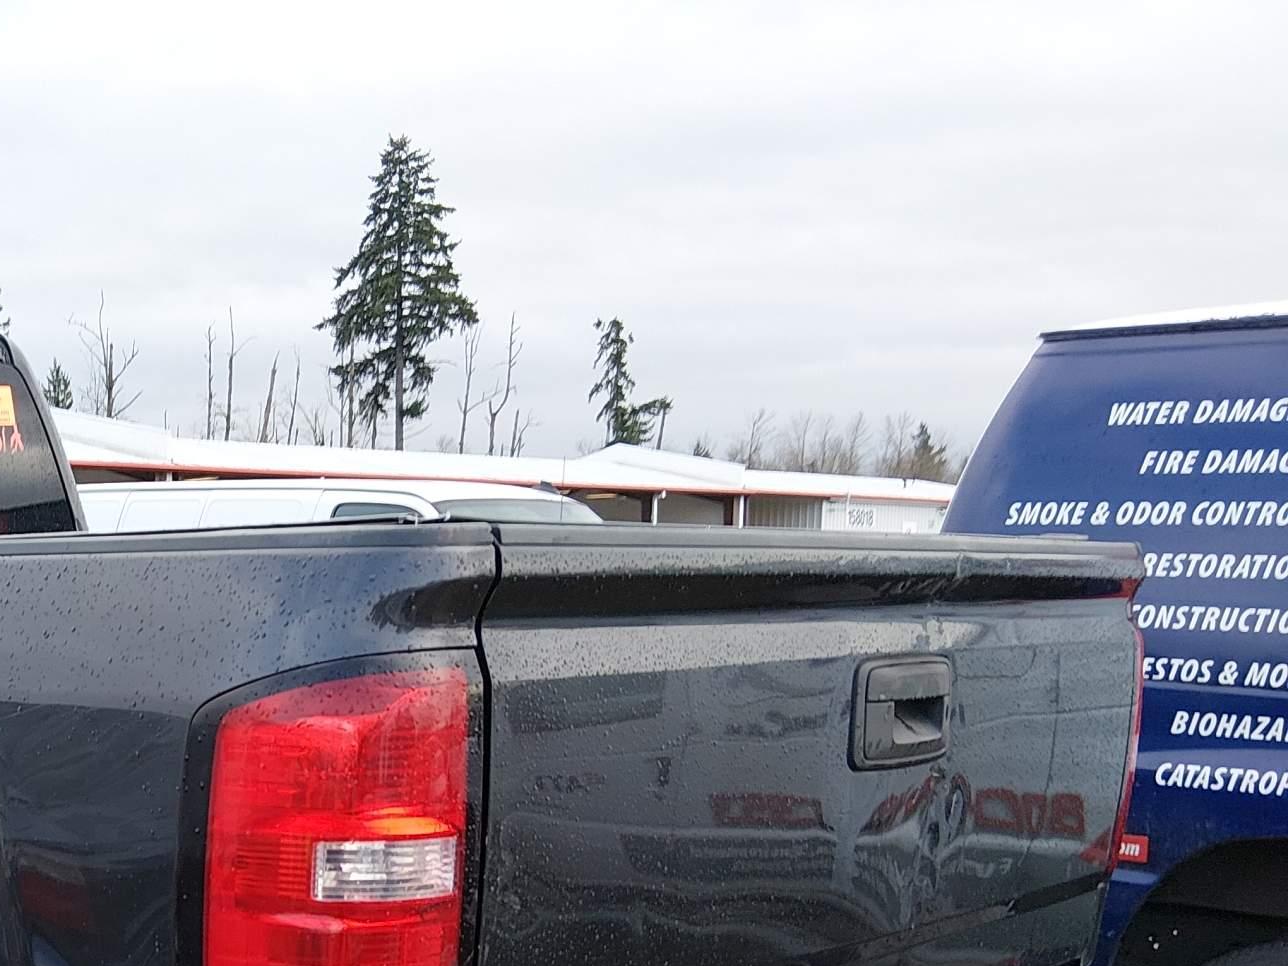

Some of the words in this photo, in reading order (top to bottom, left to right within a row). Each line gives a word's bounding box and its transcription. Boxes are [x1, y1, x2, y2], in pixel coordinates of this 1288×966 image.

[1107, 401, 1190, 426] WATER
[1193, 397, 1288, 424] DAMAG
[1139, 450, 1200, 475] FIRE
[1005, 501, 1088, 526] SMOKE
[1090, 501, 1110, 525] &
[1115, 501, 1187, 526] ODOR
[1191, 501, 1288, 526] CONTRO
[1144, 552, 1288, 580] RESTORATIO
[1143, 657, 1214, 683] ESTOS
[1218, 661, 1238, 685] &
[1244, 661, 1288, 688] MO
[1170, 710, 1288, 742] BIOHAZA
[1155, 762, 1288, 796] CATASTROP
